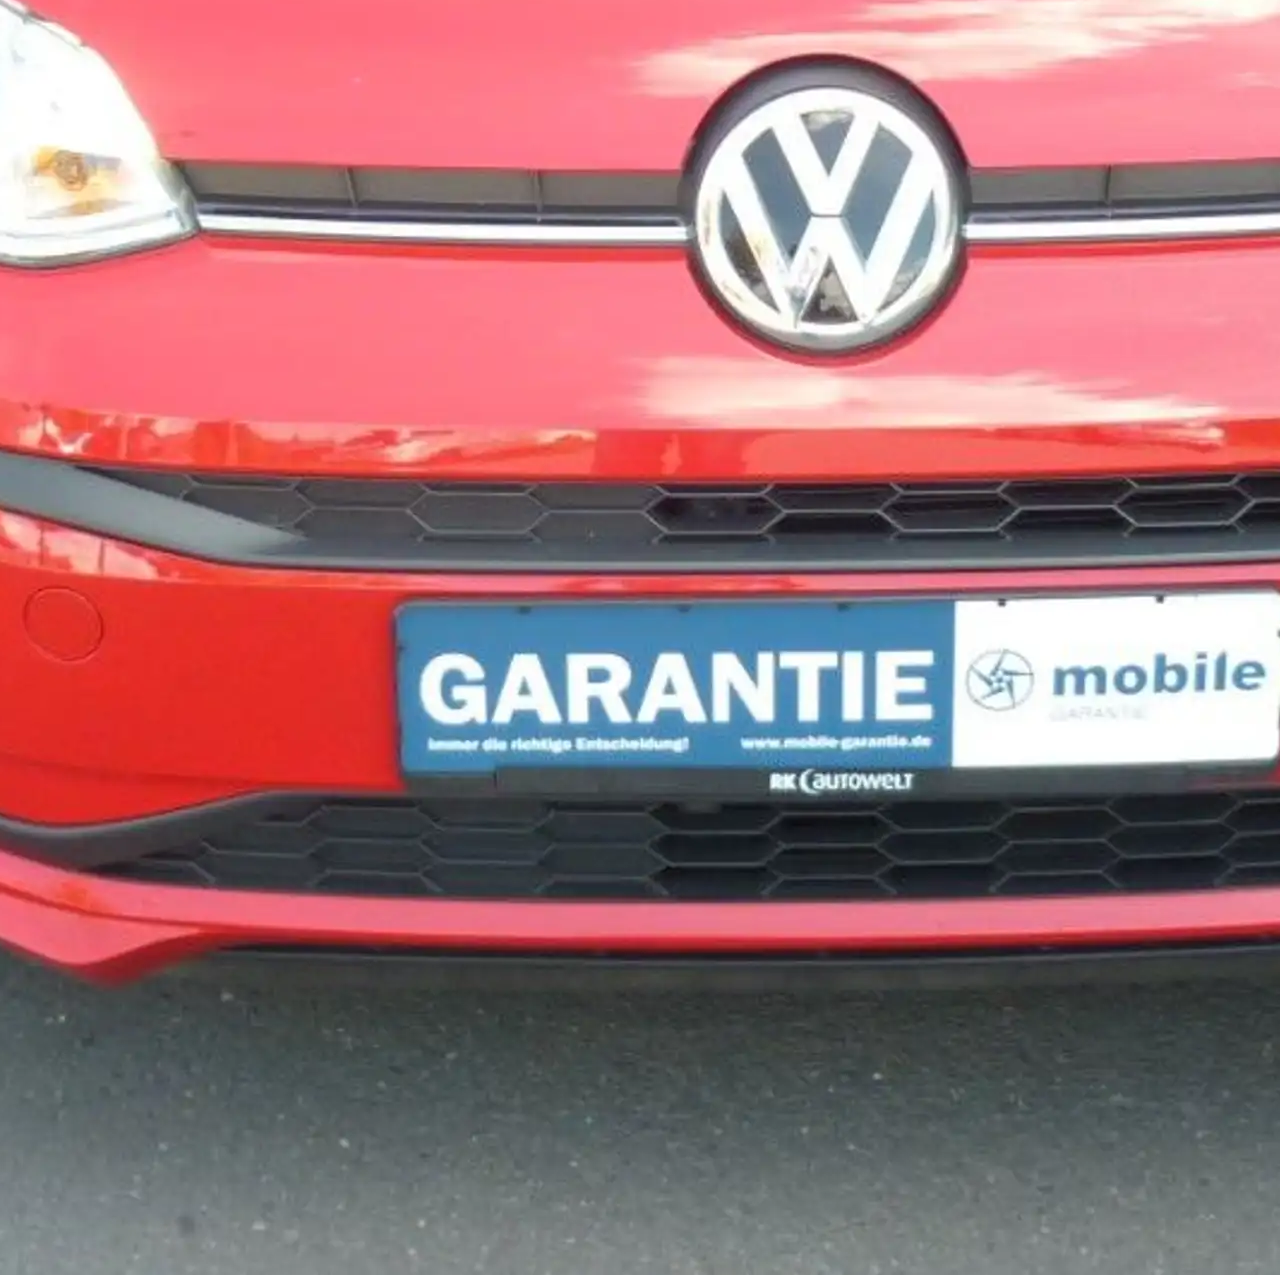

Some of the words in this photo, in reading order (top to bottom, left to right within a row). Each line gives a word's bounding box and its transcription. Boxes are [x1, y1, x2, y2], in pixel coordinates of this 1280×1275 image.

[419, 649, 935, 726] GARANTIE
[1052, 650, 1267, 697] mobile
[482, 736, 508, 752] die
[511, 736, 572, 754] richtige
[740, 733, 933, 752] www.mobile-garantie.de
